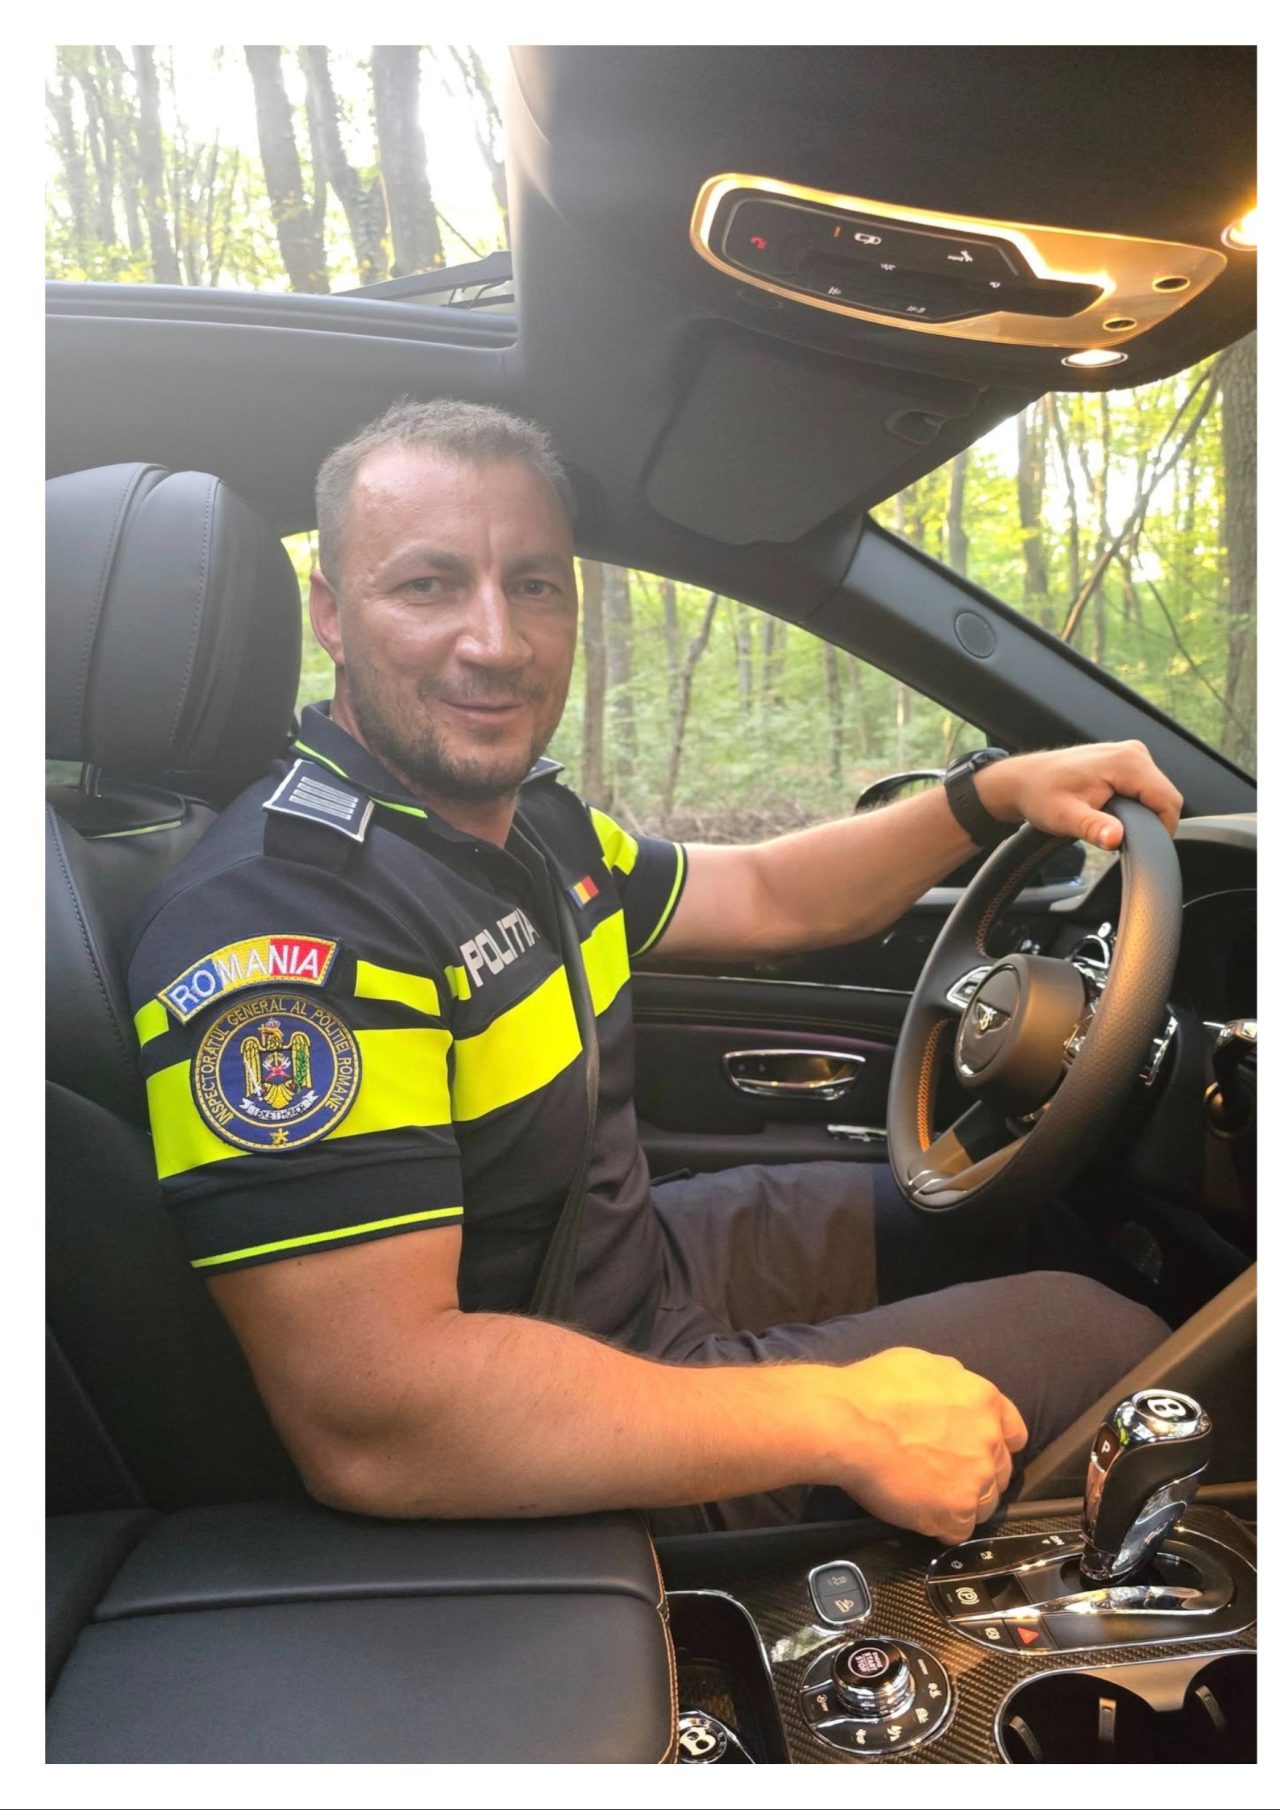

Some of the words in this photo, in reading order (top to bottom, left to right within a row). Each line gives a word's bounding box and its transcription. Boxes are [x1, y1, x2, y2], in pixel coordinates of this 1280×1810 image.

[459, 907, 540, 987] POLITIA
[168, 944, 319, 1012] ROMANIA
[227, 999, 287, 1025] GENERAL
[290, 1001, 308, 1015] AL
[310, 1009, 351, 1054] POLITIEI
[201, 1028, 234, 1126] INSPECTORATUL
[325, 1057, 353, 1112] ROMANE
